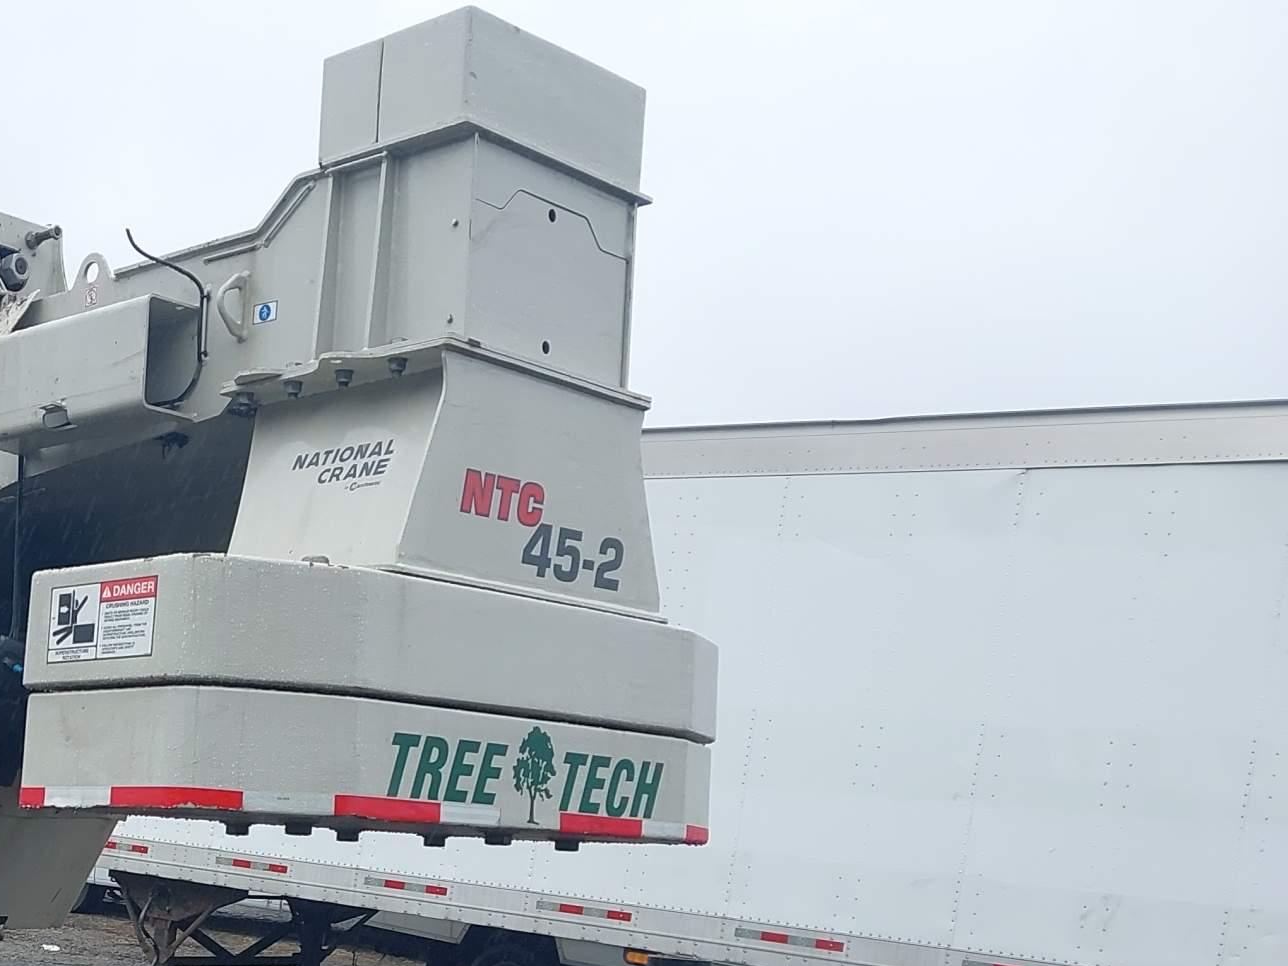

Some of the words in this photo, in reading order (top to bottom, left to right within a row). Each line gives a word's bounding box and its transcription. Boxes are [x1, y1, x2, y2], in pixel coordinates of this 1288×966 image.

[292, 439, 394, 471] NATIONAL
[317, 458, 391, 484] CRANE
[459, 468, 545, 528] NTC
[521, 522, 625, 592] 45-2
[113, 581, 155, 597] DANGER
[386, 732, 509, 805] TREE
[559, 752, 664, 819] TECH
